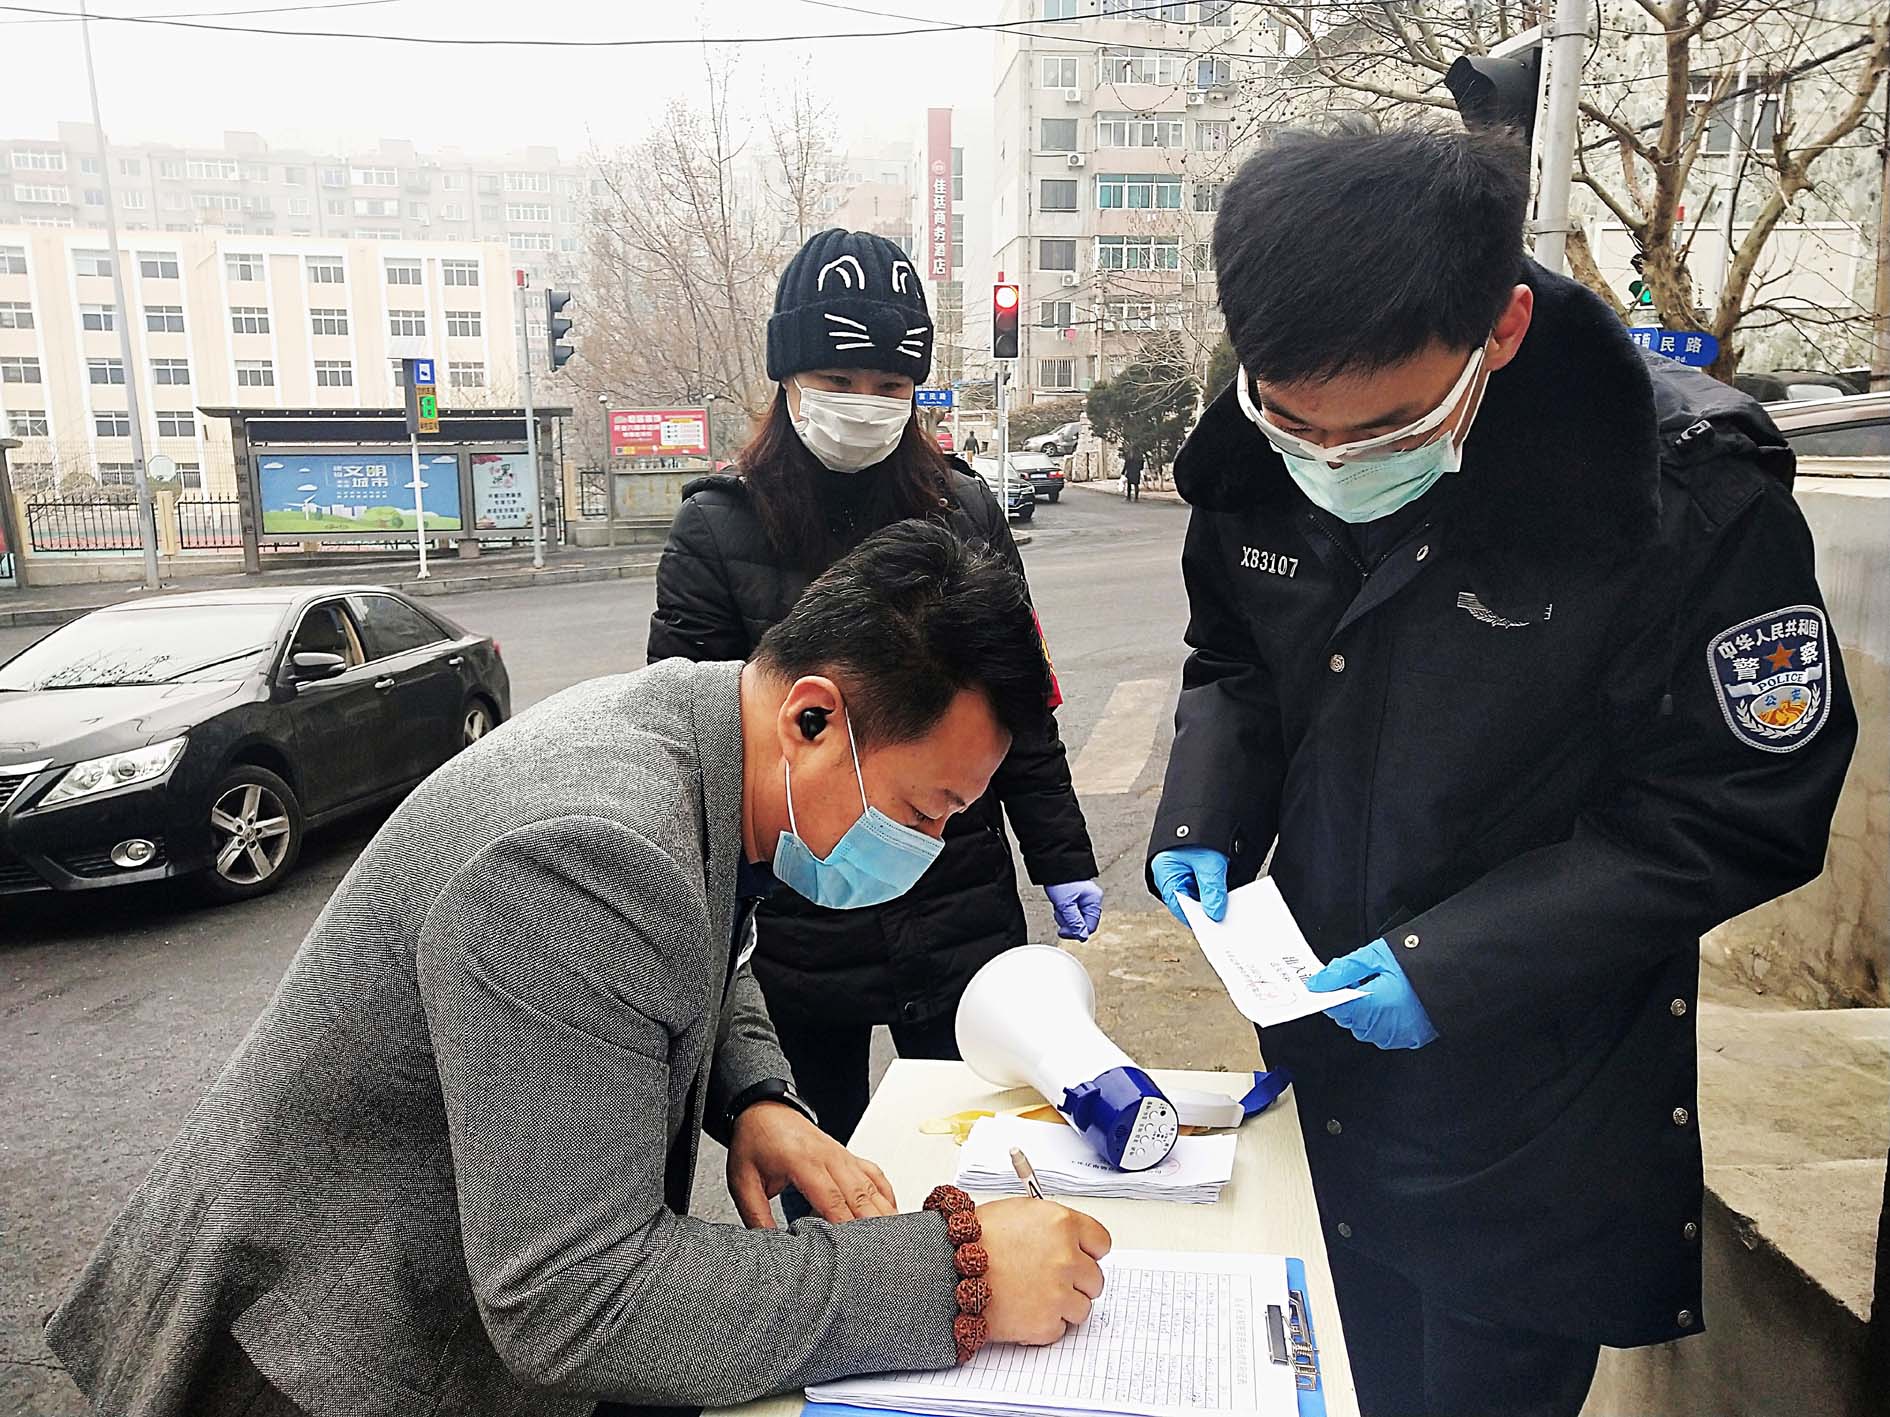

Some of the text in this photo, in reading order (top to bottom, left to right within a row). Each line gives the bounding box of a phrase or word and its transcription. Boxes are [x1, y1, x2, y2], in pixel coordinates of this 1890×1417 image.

[343, 465, 387, 477] 文明
[1240, 546, 1299, 578] X83107
[1717, 619, 1819, 660] 中华人民共和国
[1757, 672, 1804, 692] POLICE
